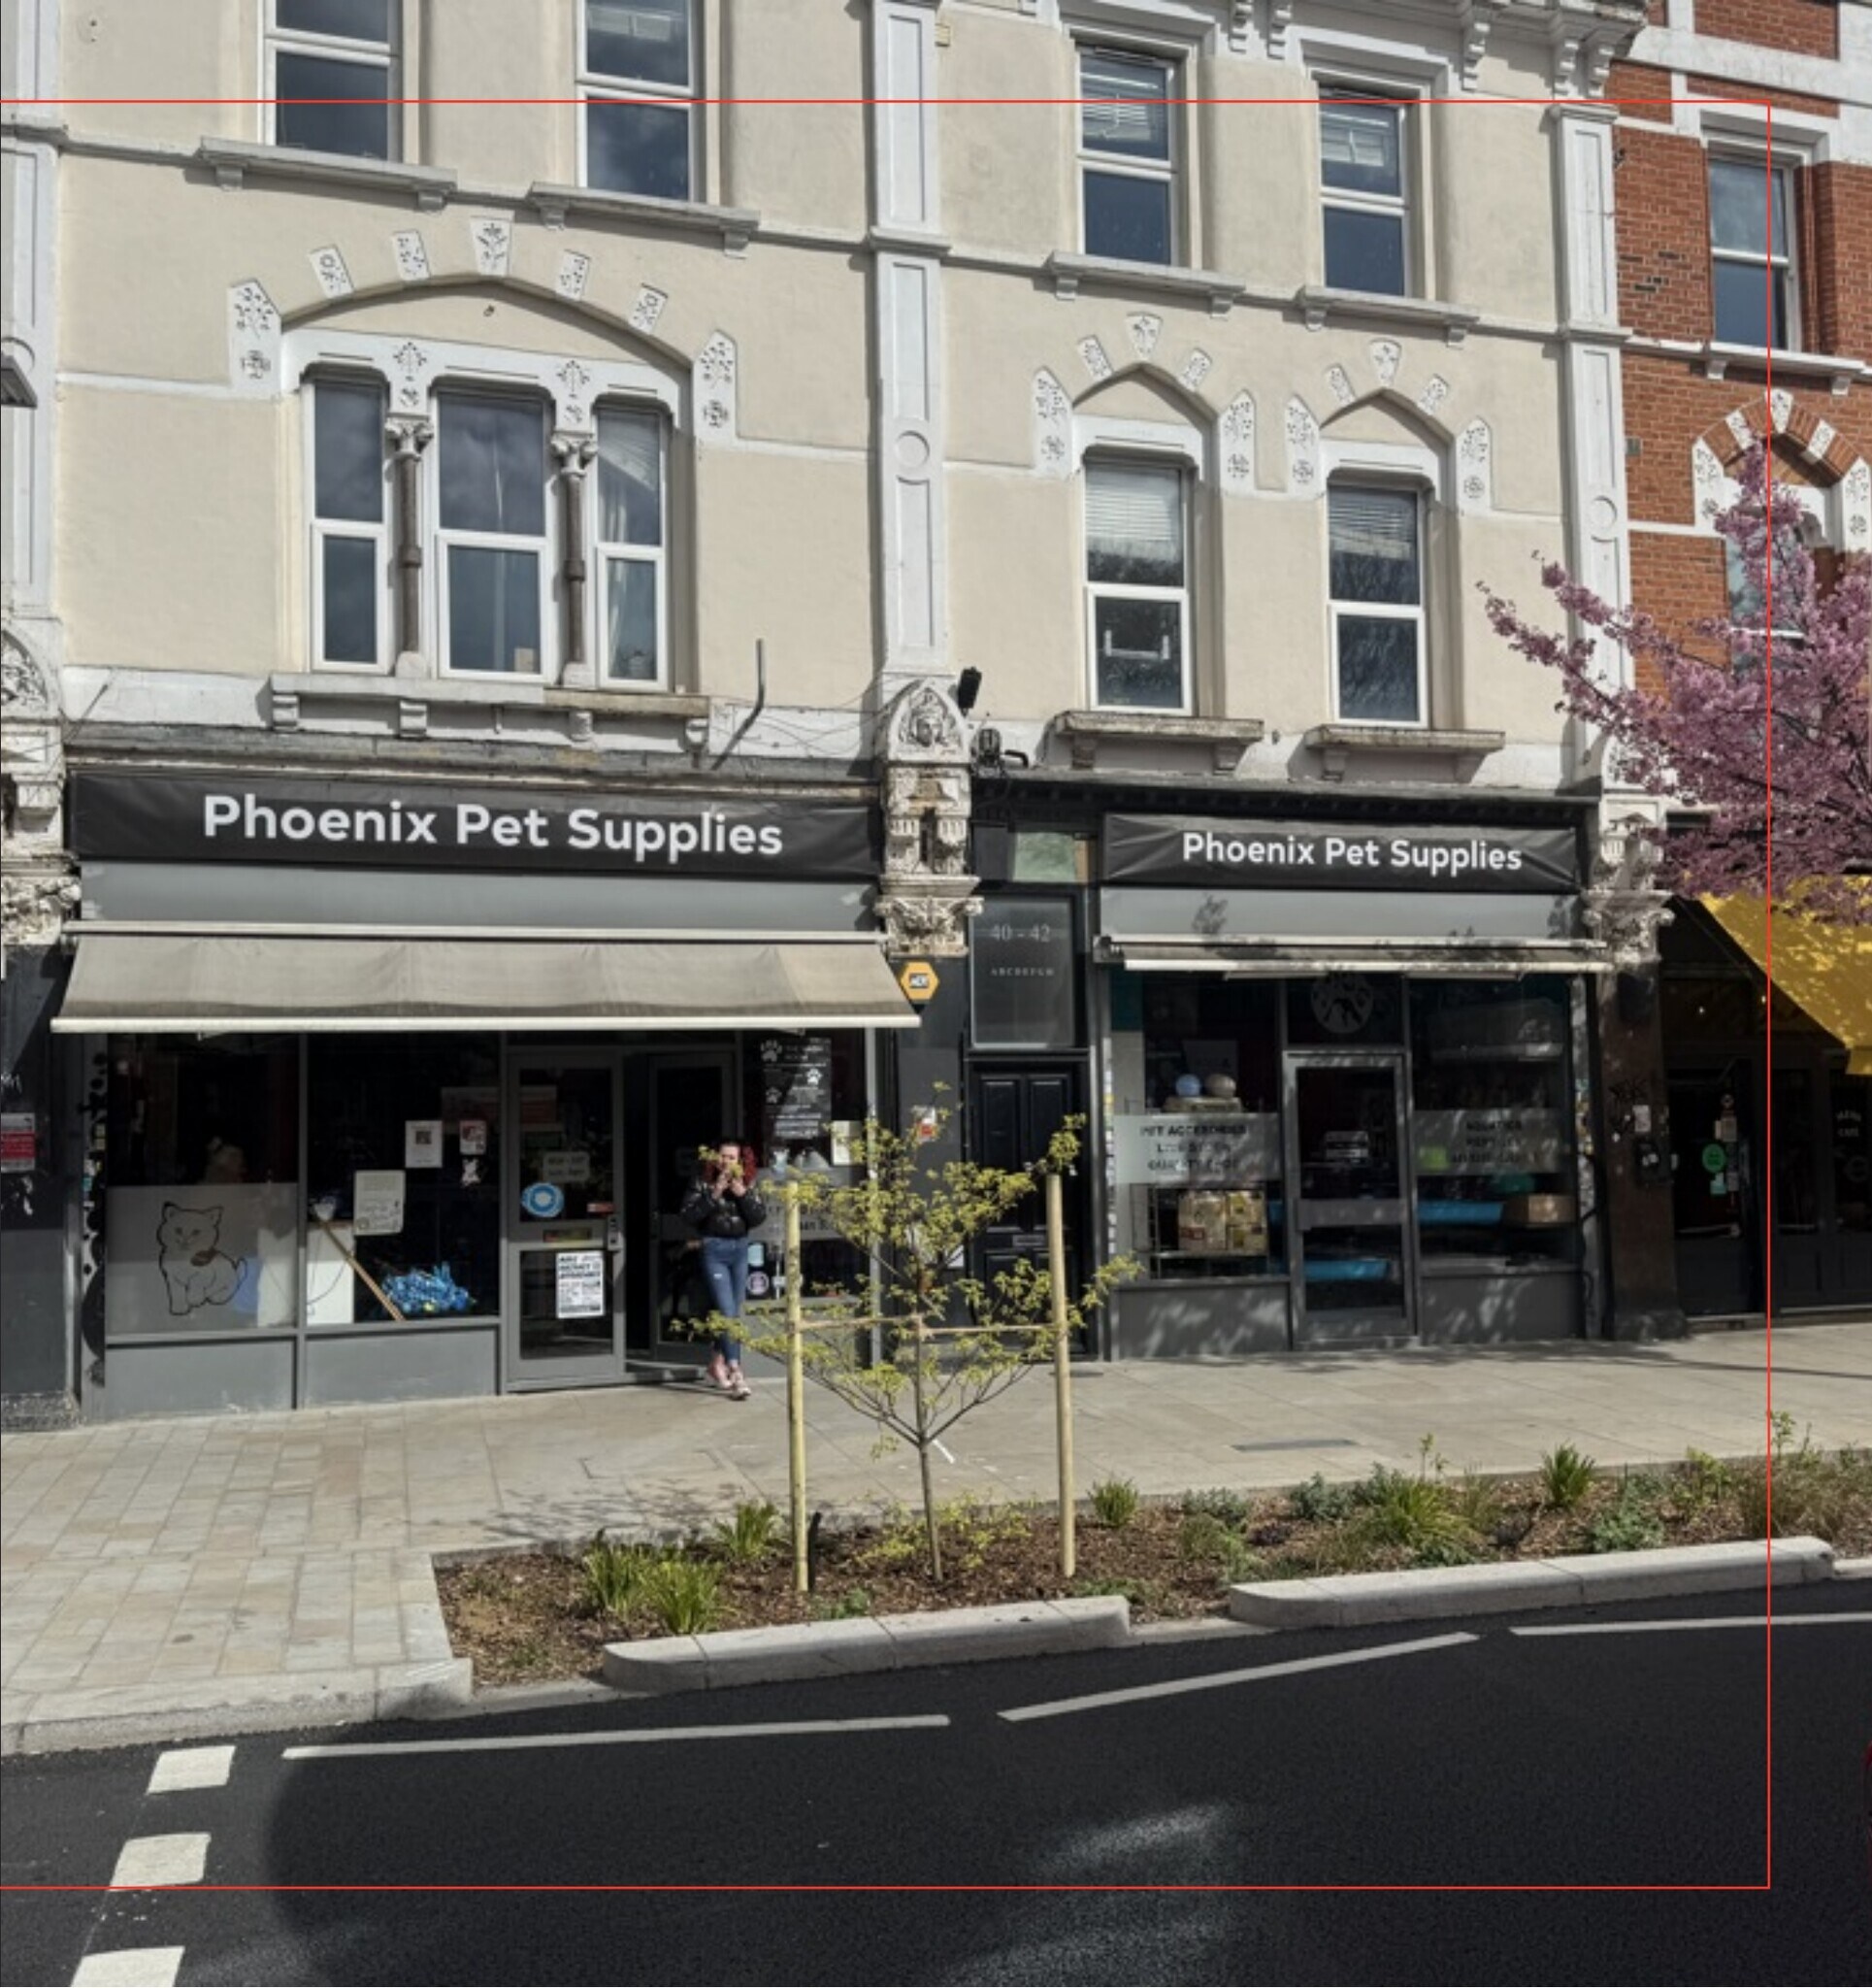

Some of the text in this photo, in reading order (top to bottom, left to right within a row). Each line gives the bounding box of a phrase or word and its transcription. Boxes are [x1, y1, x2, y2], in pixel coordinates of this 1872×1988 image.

[204, 793, 784, 864] Phoenix Pet Supplies
[1182, 832, 1523, 878] Phoenix Pet Supplies
[990, 923, 1013, 943] 40
[1029, 923, 1051, 944] 42
